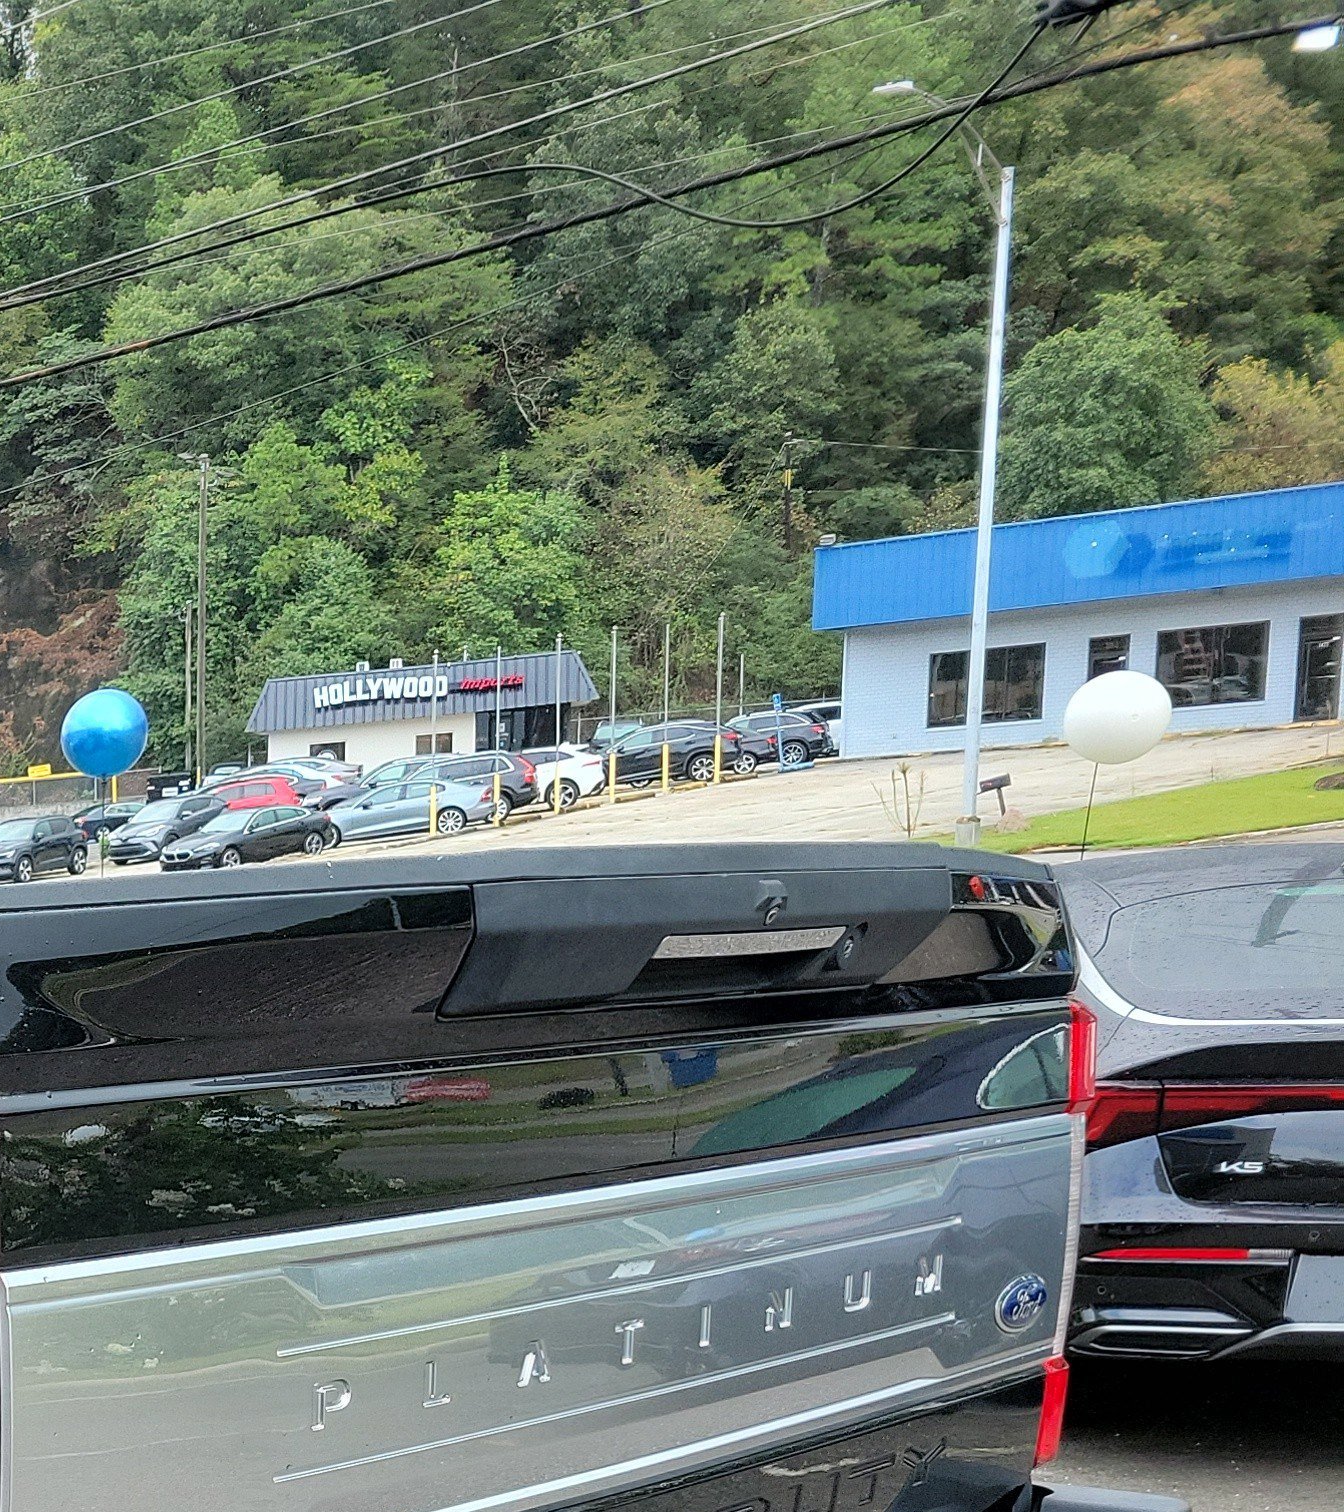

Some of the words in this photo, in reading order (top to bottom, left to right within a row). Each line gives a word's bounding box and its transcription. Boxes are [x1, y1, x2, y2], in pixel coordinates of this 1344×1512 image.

[313, 675, 449, 709] HOLLYWOOD
[1214, 1161, 1264, 1174] K5
[312, 1253, 945, 1431] PLATINUM
